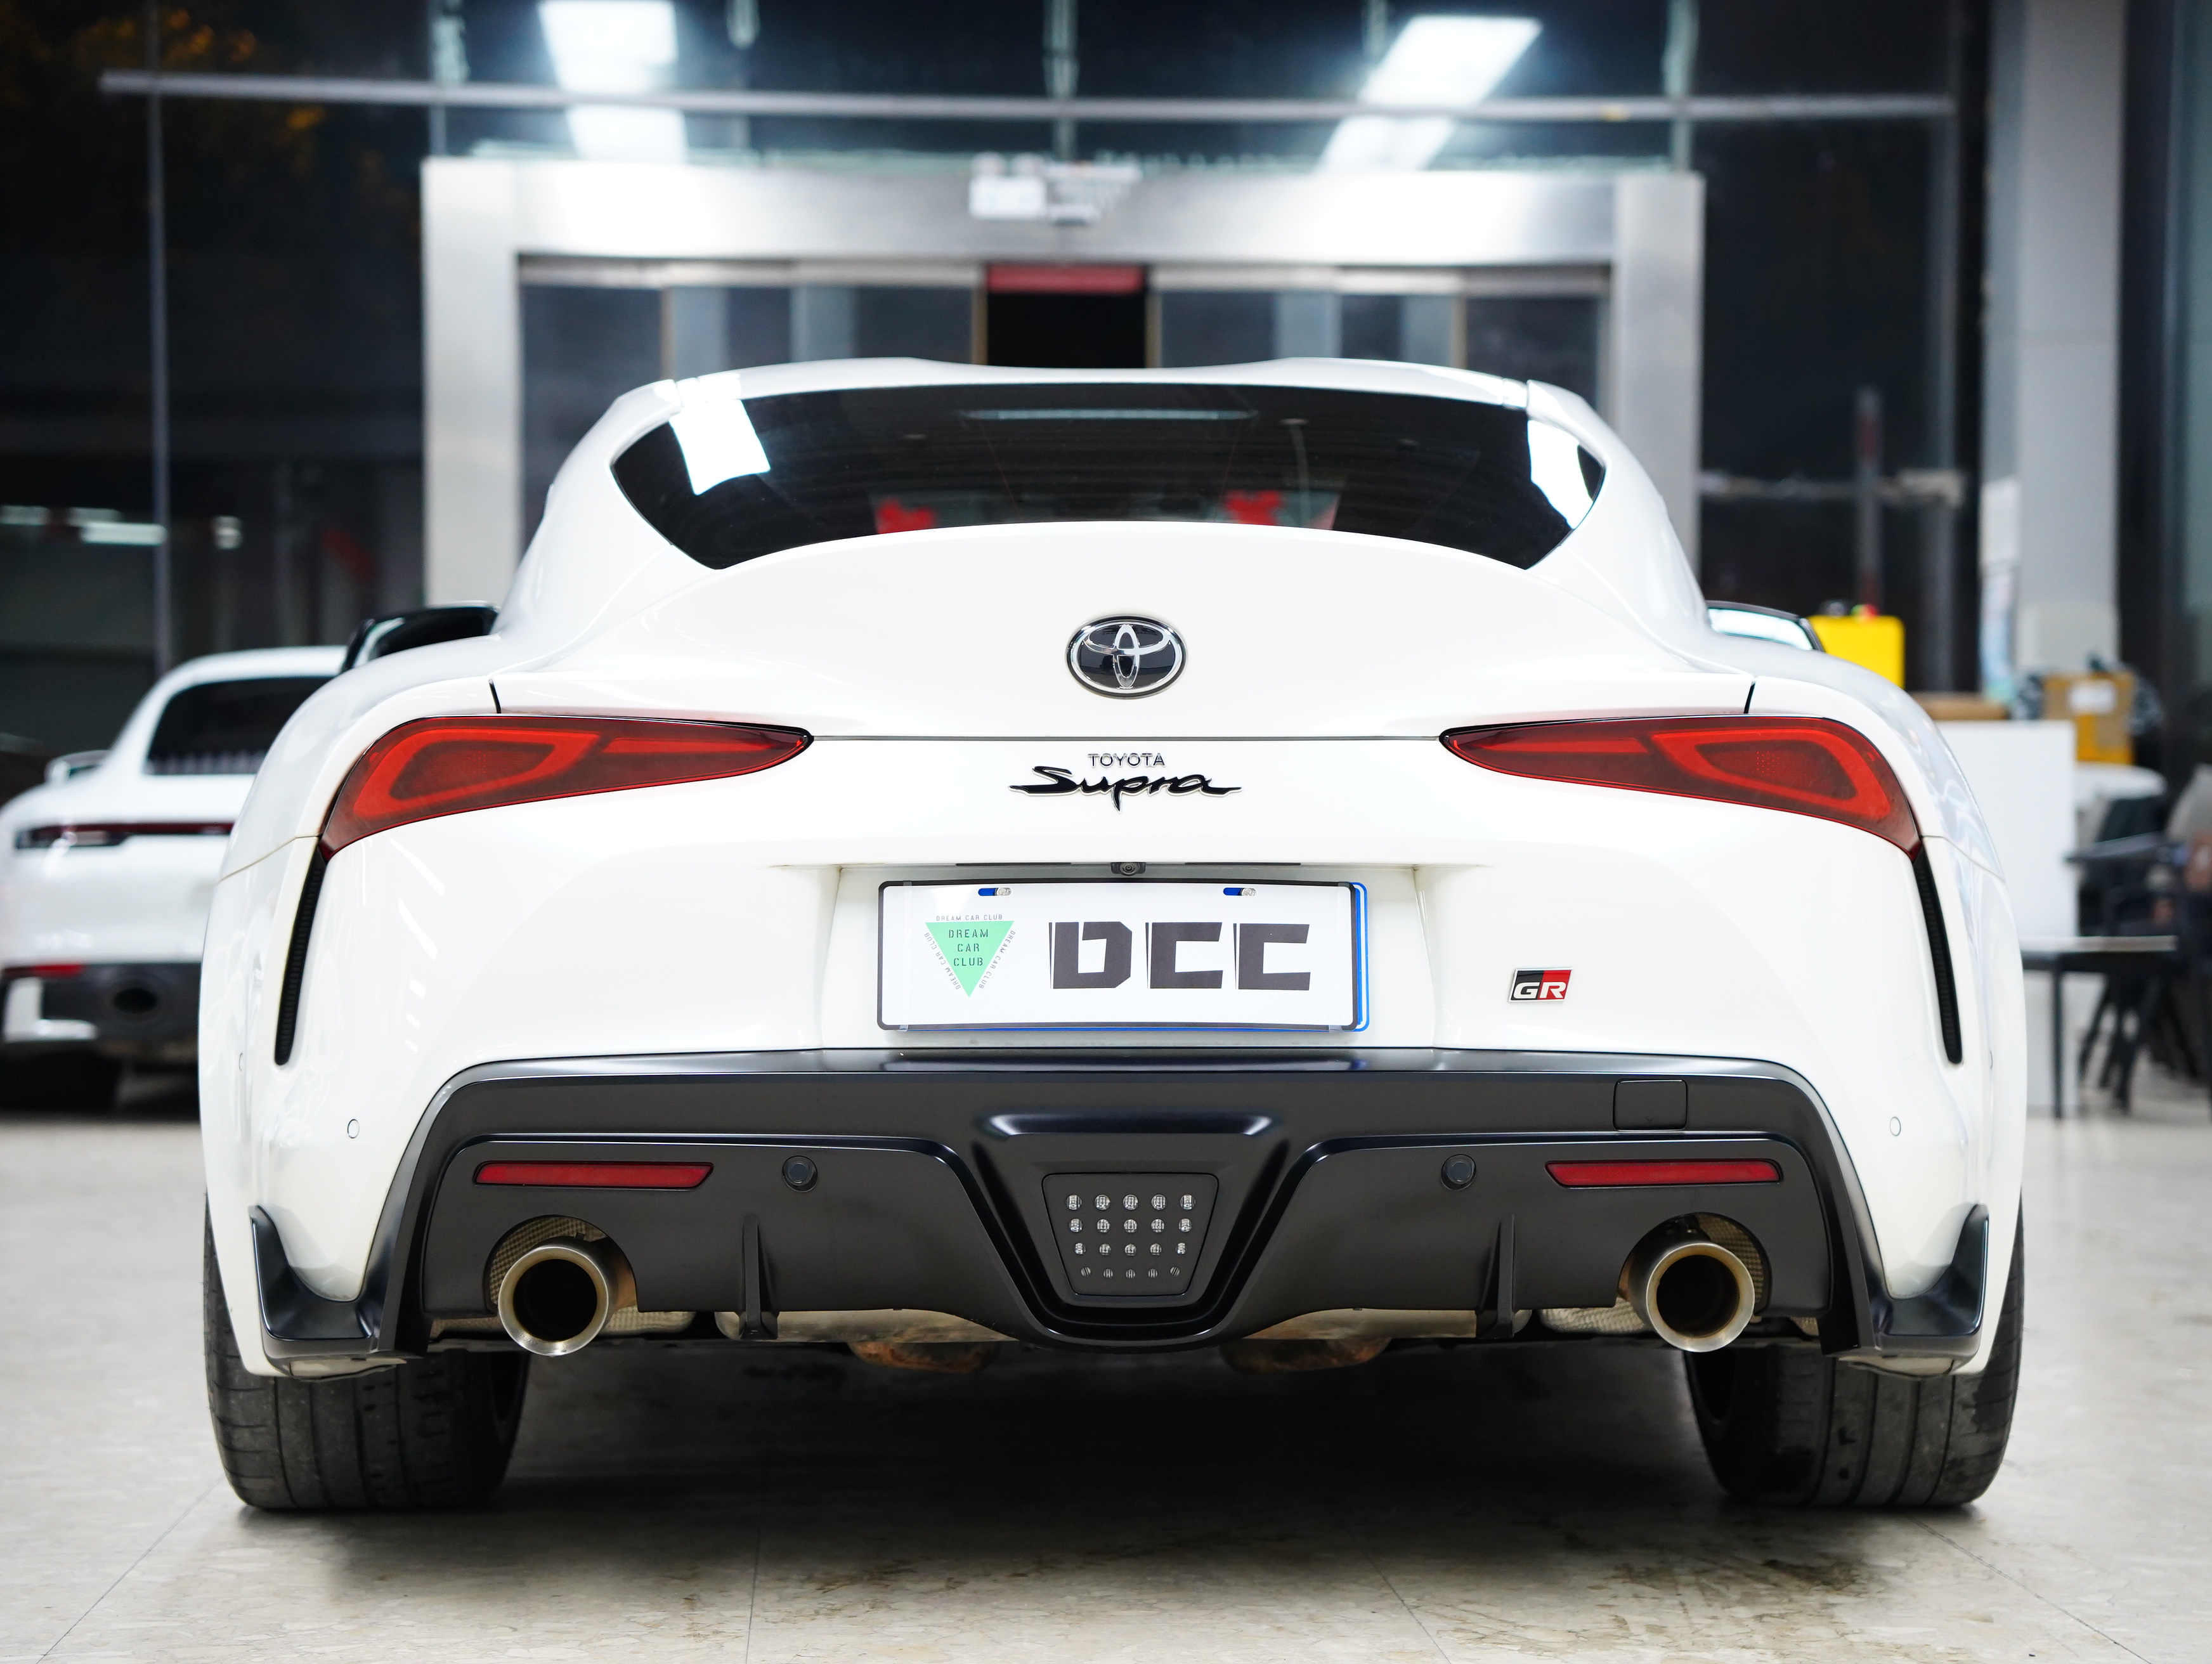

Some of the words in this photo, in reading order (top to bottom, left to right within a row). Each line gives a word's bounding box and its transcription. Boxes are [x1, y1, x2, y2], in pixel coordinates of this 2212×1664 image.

[1088, 753, 1166, 768] TOYOTA
[1008, 765, 1242, 814] Supra
[924, 932, 937, 950] CLUB
[949, 929, 988, 938] DREAM
[999, 930, 1015, 954] DREAM
[958, 943, 979, 952] CAR
[1048, 921, 1310, 991] DCC
[935, 951, 946, 965] CAR
[953, 958, 983, 966] CLUB
[990, 956, 1001, 969] CAR
[945, 966, 961, 990] DREAM
[979, 971, 992, 989] CLUB
[1513, 982, 1566, 999] GR
